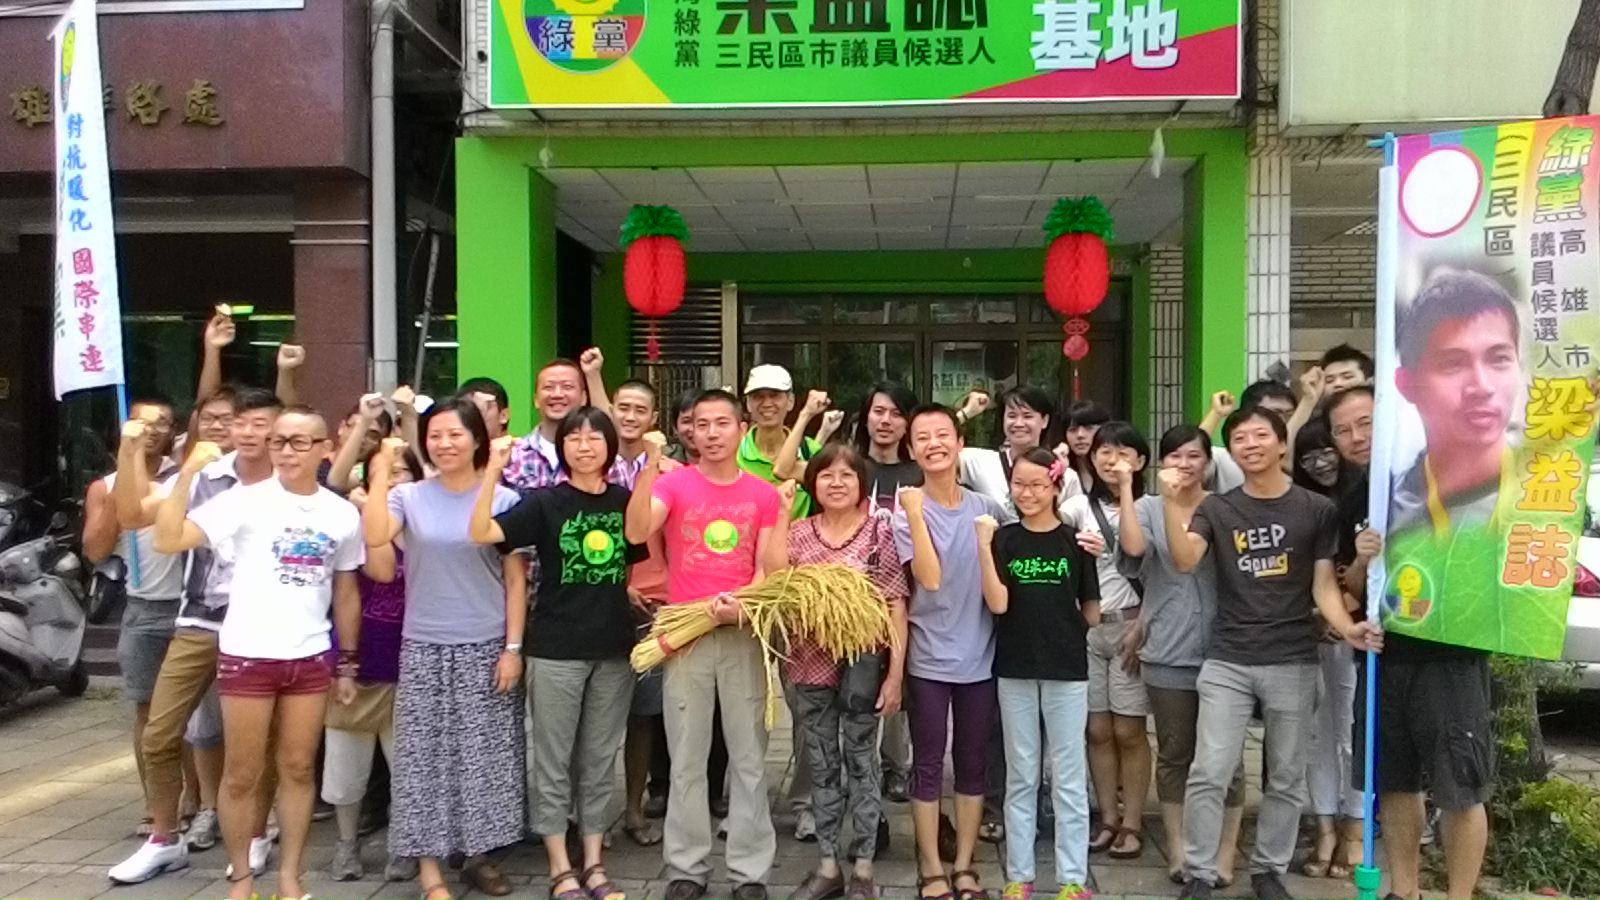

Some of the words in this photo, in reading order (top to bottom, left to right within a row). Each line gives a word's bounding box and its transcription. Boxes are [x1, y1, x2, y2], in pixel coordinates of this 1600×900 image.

[536, 18, 629, 53] 綠黨
[673, 0, 701, 68] 綠黨
[715, 37, 996, 69] 三民區市議員候選人
[1030, 0, 1180, 71] 基地
[10, 79, 225, 127] 雄絡處
[1532, 125, 1595, 225] 綠黨
[73, 248, 105, 373] 國際串連
[1530, 232, 1562, 369] 議員候選人
[1559, 228, 1591, 369] 高雄市
[1503, 375, 1596, 589] 梁益誌
[1232, 523, 1286, 555] KEEP
